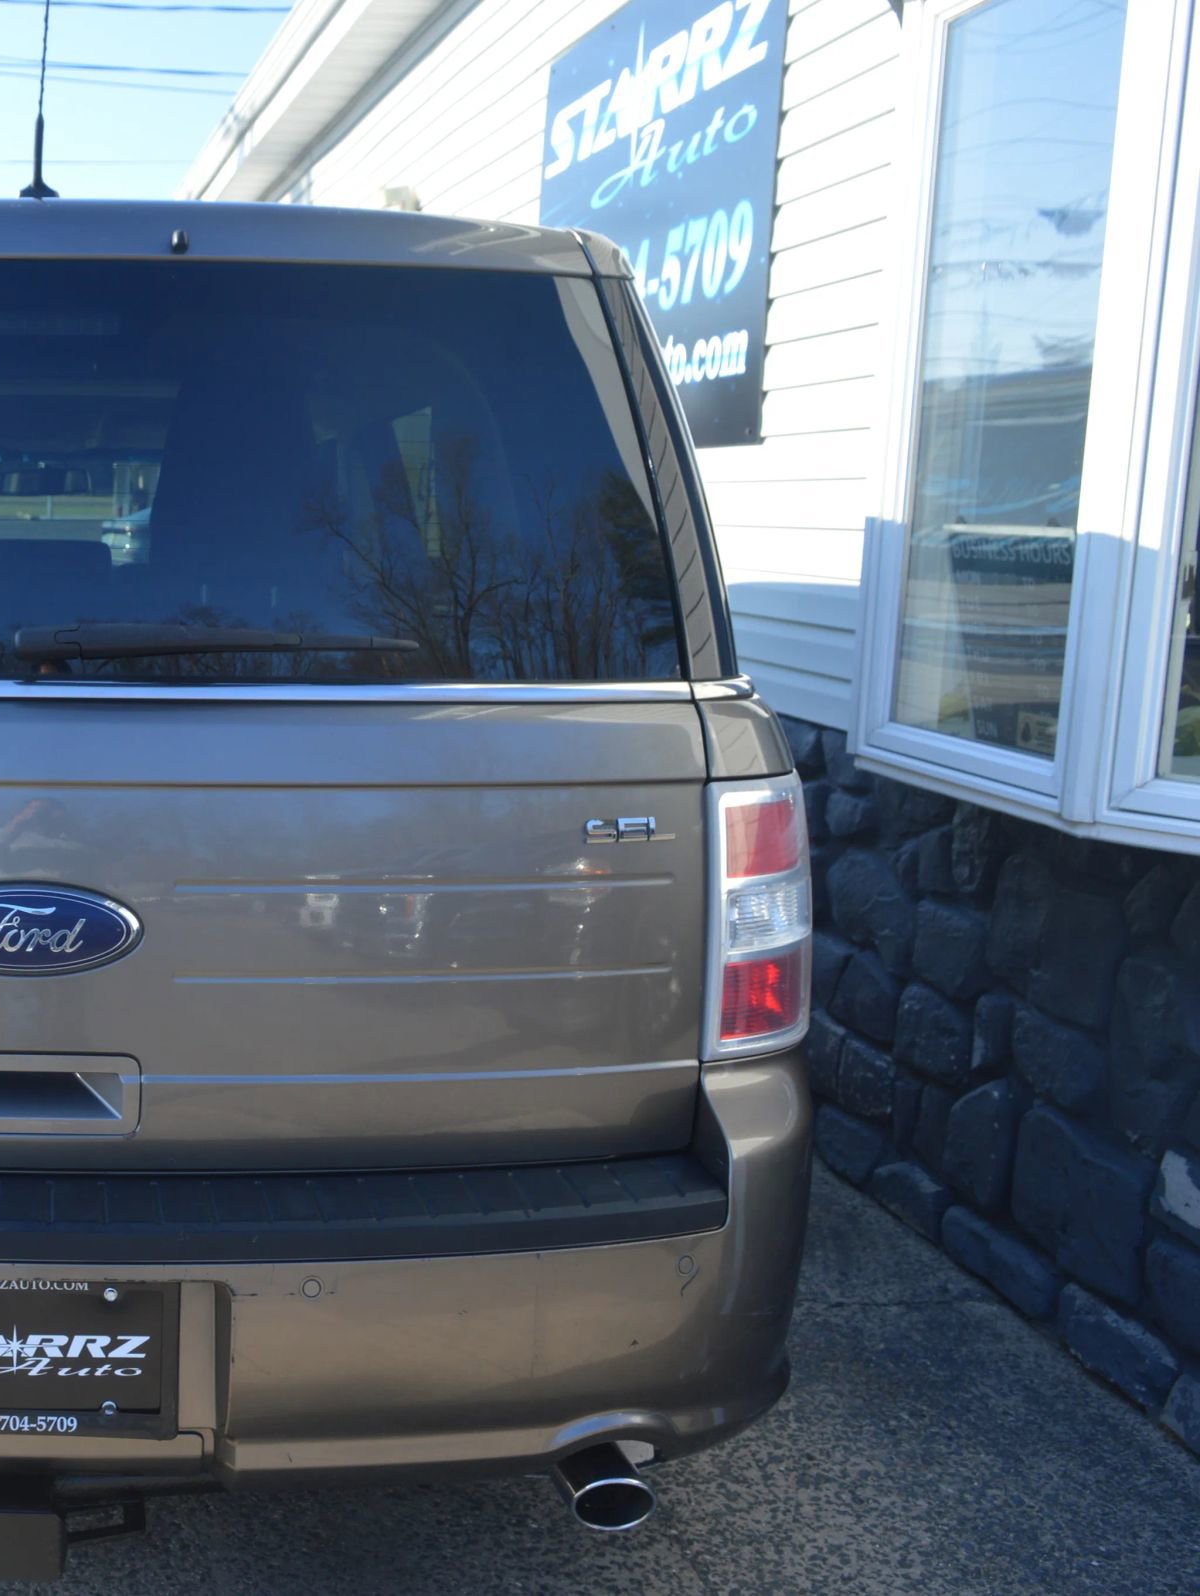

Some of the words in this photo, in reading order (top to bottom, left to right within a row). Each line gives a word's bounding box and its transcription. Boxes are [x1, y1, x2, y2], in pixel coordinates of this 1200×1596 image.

[544, 0, 769, 181] STARRZ
[590, 103, 758, 210] Auto
[621, 199, 753, 312] 4-5709
[952, 537, 1017, 561] BUSINESS
[1020, 542, 1072, 566] HOURS
